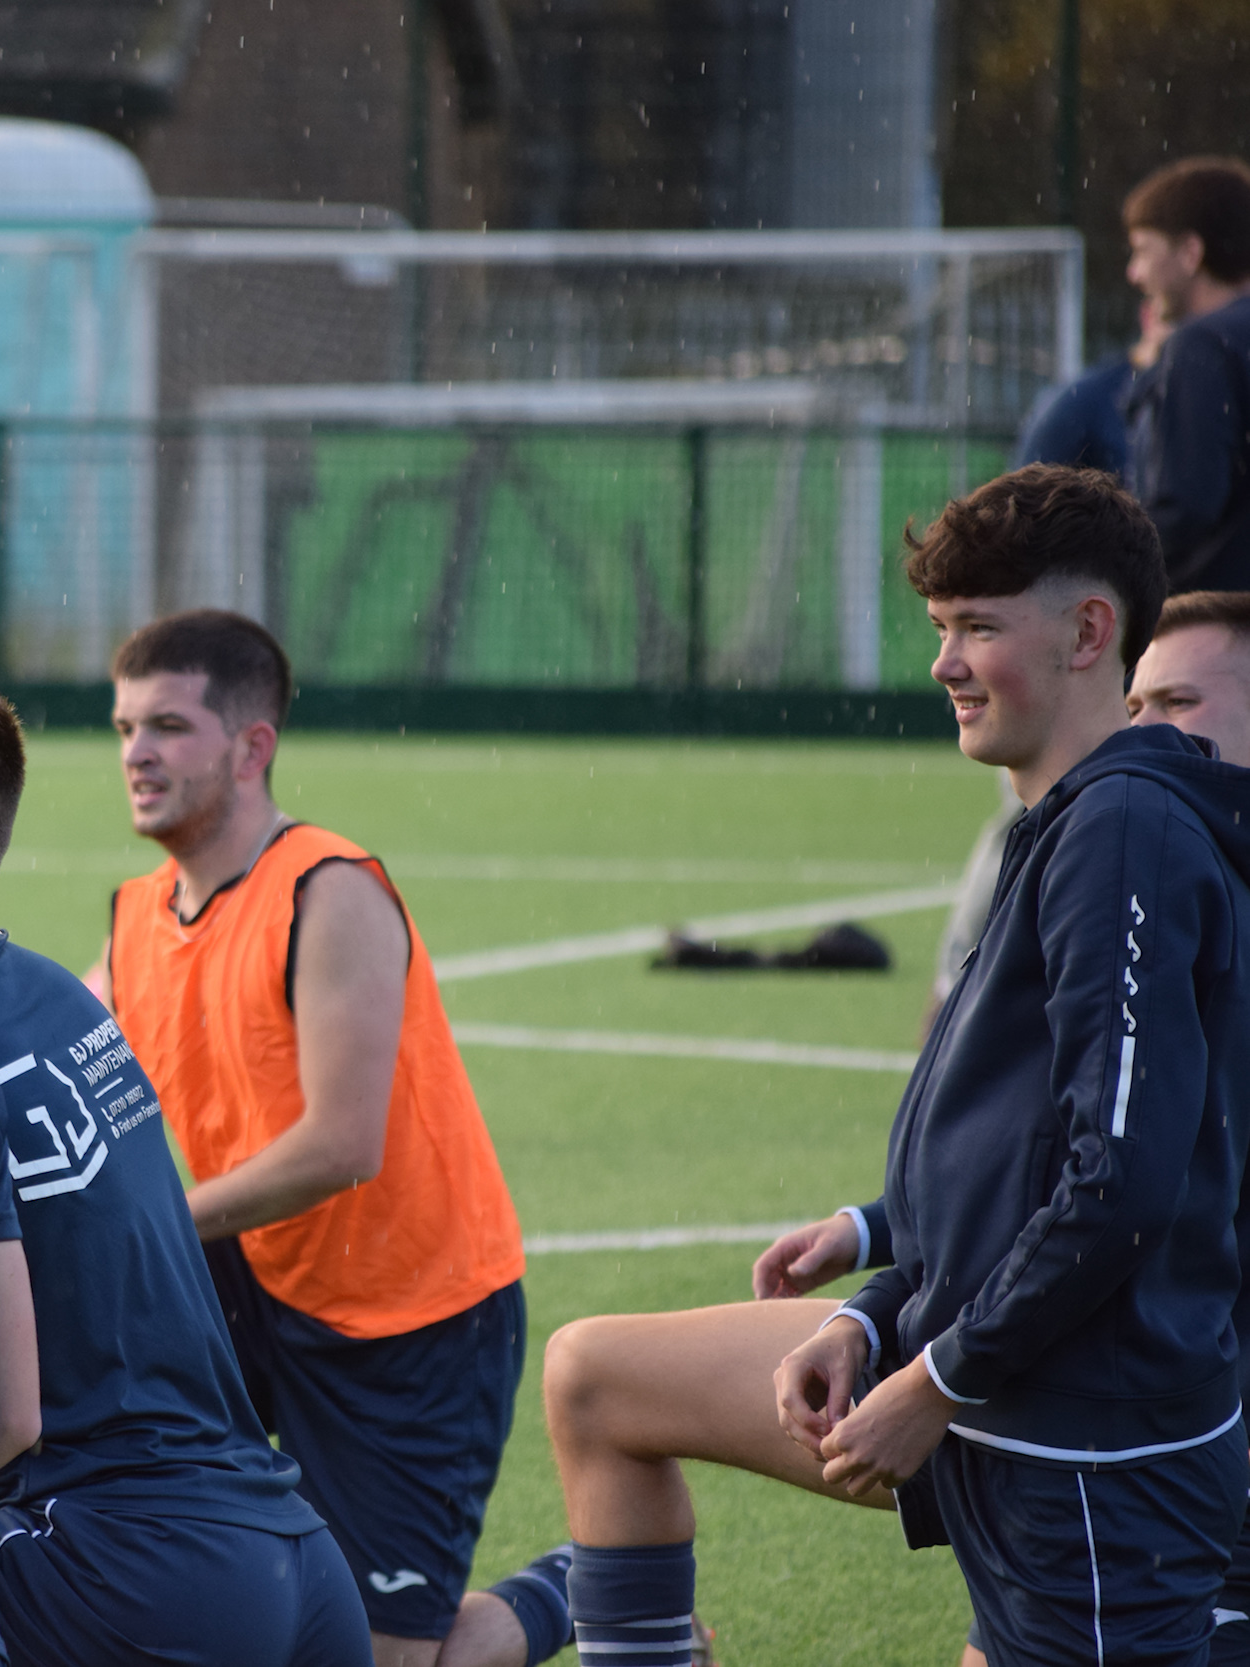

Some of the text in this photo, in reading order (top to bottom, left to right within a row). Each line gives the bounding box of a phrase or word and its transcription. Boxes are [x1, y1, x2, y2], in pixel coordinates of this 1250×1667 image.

[69, 1043, 88, 1066] GJ
[117, 1117, 132, 1135] Find
[129, 1115, 139, 1128] us
[136, 1110, 146, 1123] on
